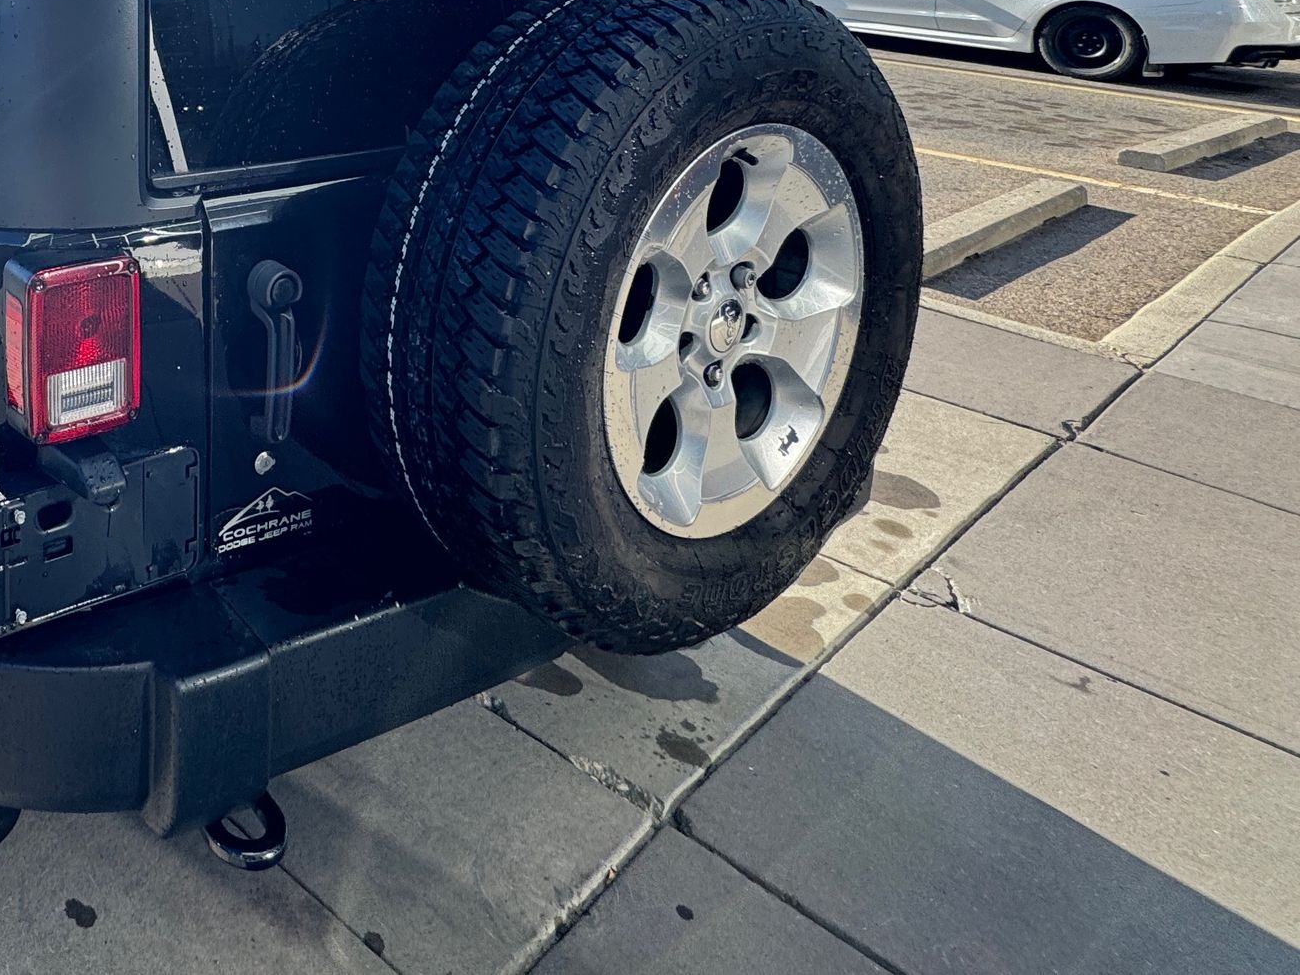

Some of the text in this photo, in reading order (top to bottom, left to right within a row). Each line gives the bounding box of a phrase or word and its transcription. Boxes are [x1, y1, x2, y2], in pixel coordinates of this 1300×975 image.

[218, 519, 312, 554] DODGE JEEP RAM
[222, 509, 312, 542] COCHRANE
